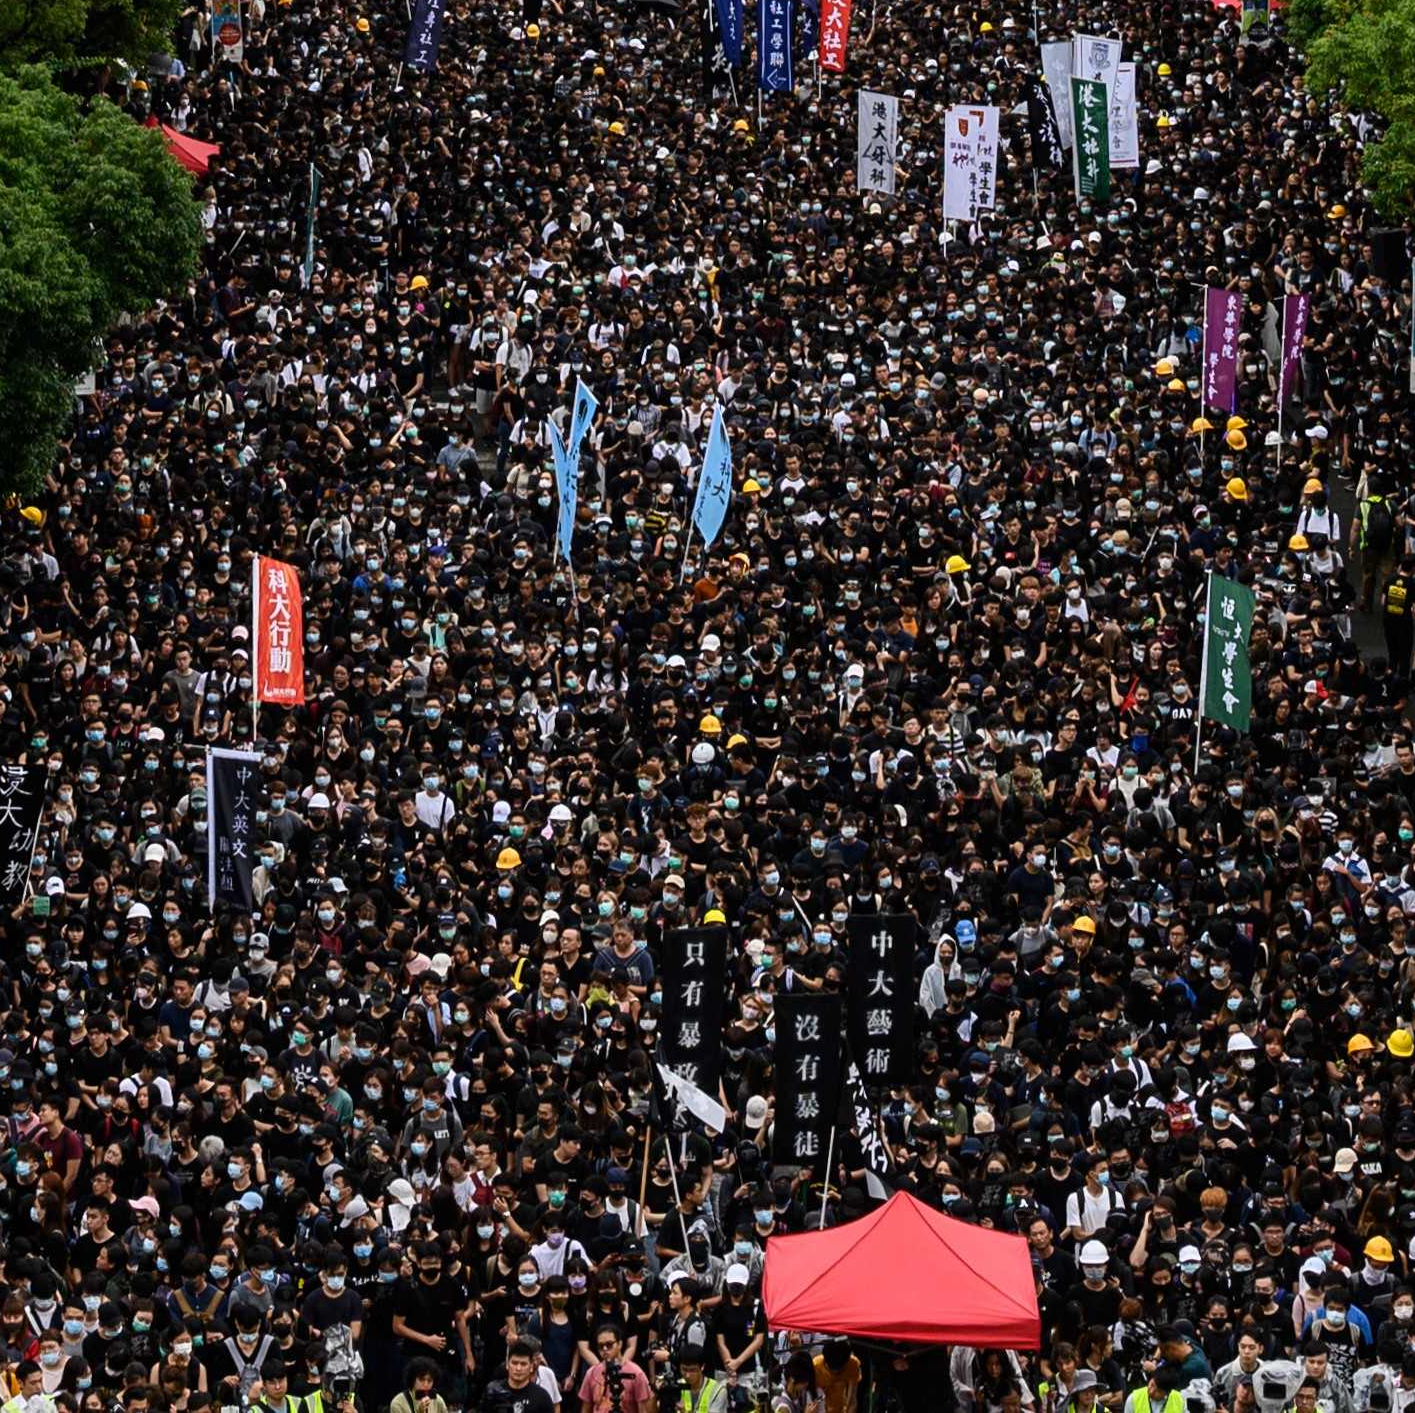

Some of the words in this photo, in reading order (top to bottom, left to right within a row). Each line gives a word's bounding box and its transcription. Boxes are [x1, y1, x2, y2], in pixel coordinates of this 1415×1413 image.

[769, 0, 785, 68] 社工學聯
[268, 568, 292, 674] 科大行動
[232, 766, 252, 858] 中大英文
[864, 930, 895, 1075] 中大藝術
[793, 1014, 821, 1158] 沒有暴徒
